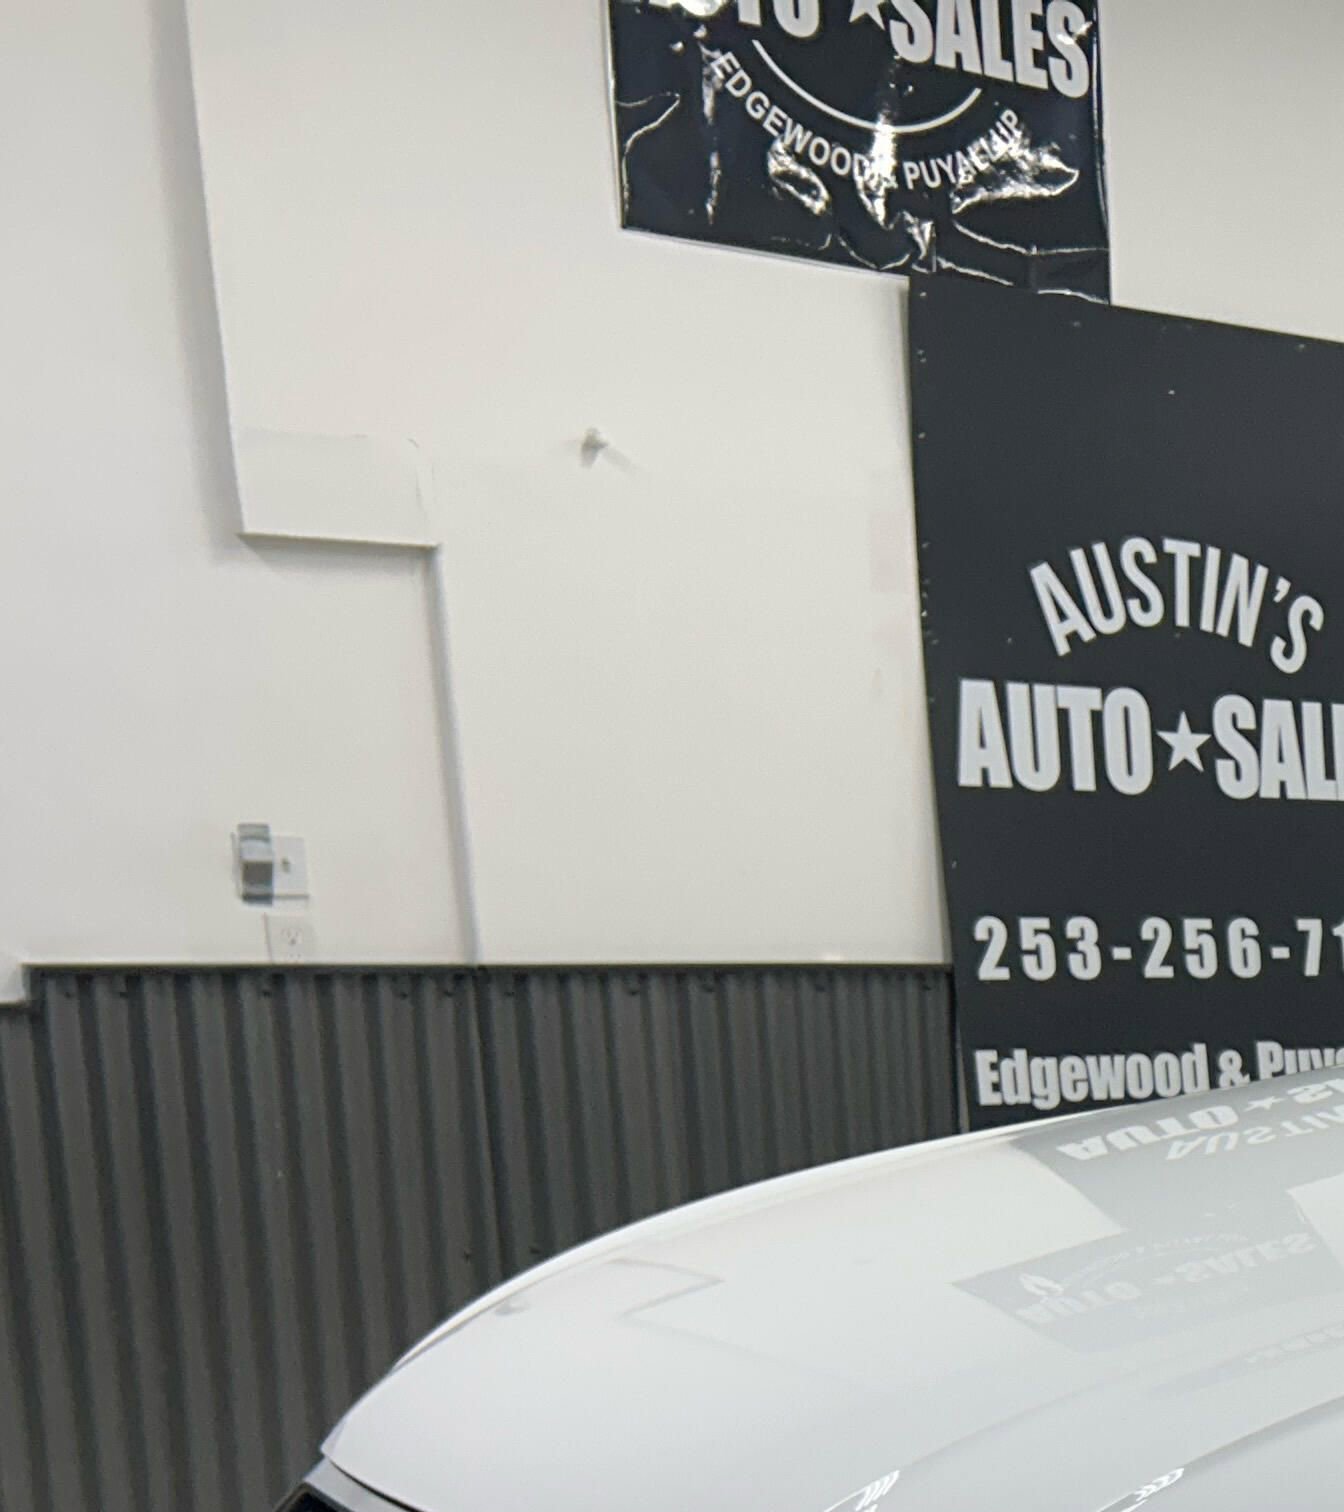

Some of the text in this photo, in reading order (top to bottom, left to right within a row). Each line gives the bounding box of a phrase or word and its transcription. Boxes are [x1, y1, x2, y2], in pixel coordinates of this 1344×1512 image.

[889, 0, 1090, 98] SALES
[710, 51, 871, 184] EDGEWOOD
[1029, 536, 1324, 674] AUSTIN'S
[957, 677, 1153, 795] AUTO
[974, 1043, 1209, 1111] Edgewood
[1217, 1048, 1250, 1089] &
